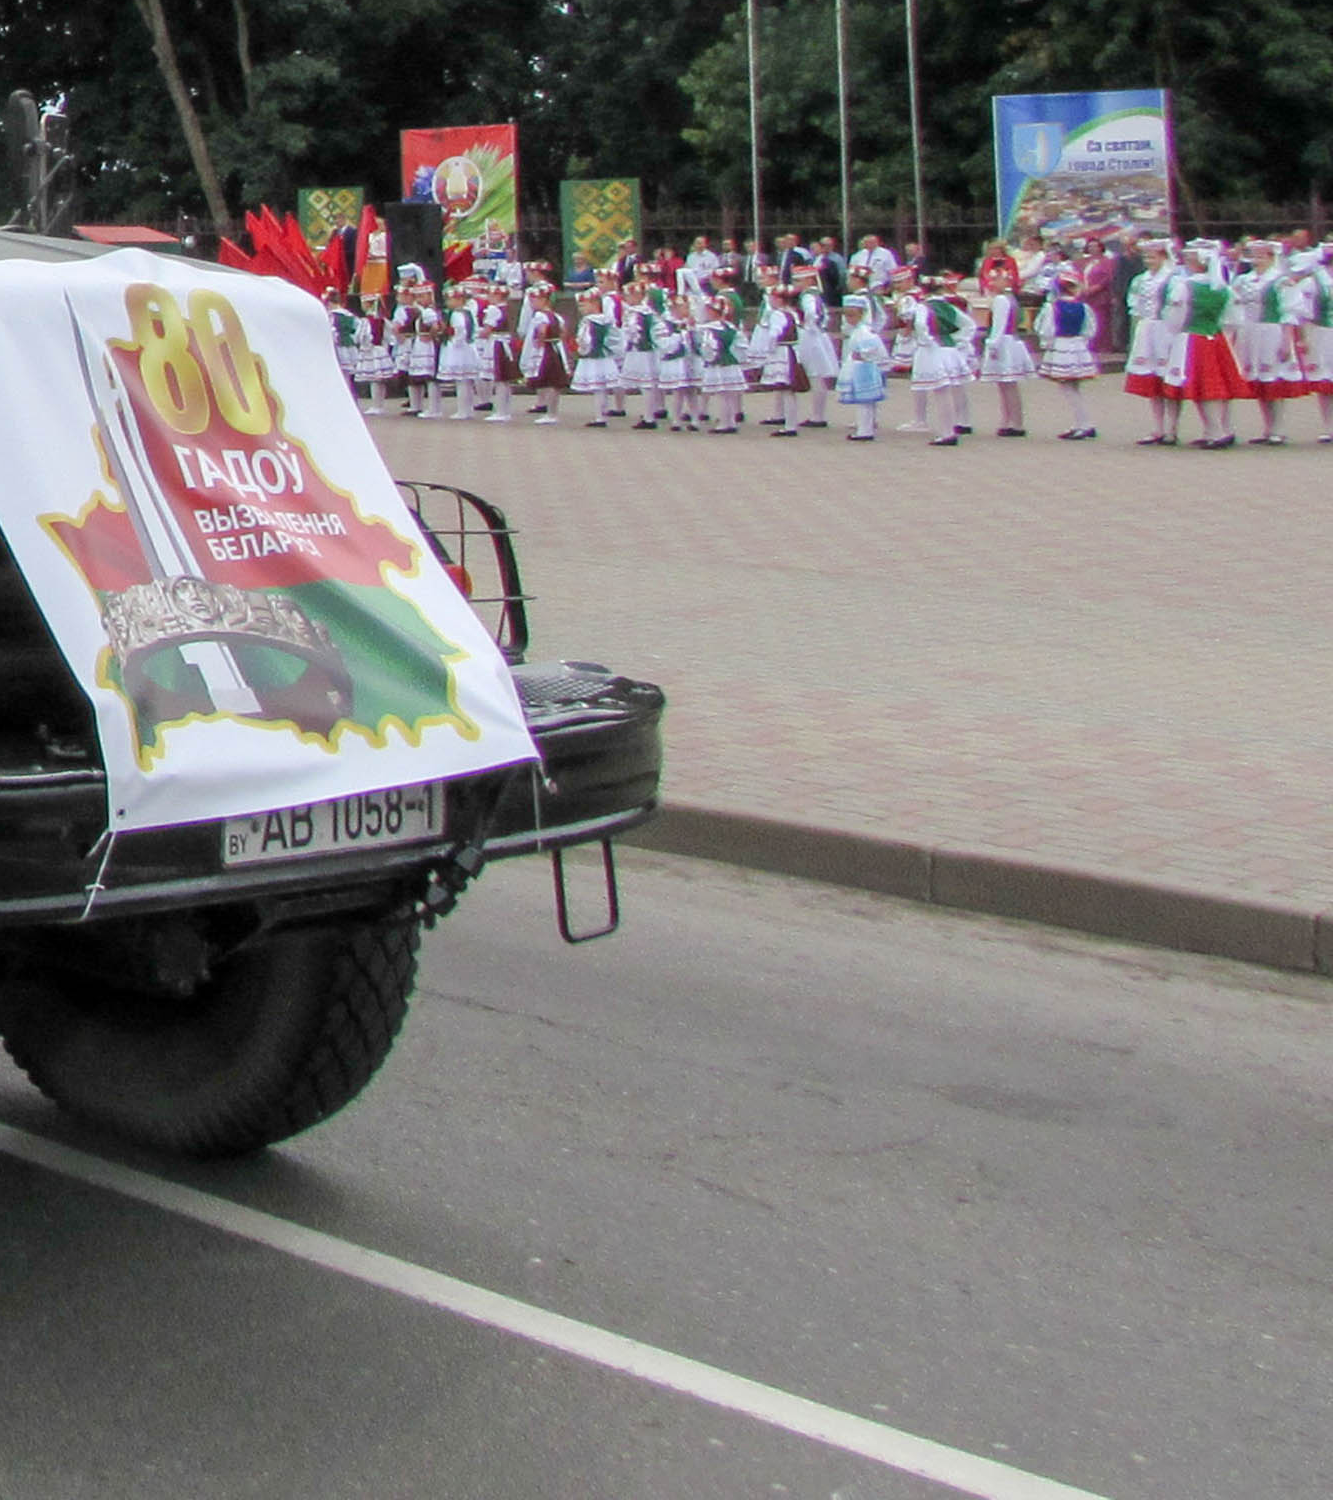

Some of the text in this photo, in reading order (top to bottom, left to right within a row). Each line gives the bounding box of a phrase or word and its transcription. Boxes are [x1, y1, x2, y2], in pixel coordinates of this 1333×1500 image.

[125, 283, 272, 435] 80
[172, 441, 305, 503] ГАДОЎ
[193, 503, 348, 536] ВЫЗВЛЕННЯ
[229, 833, 248, 856] BY
